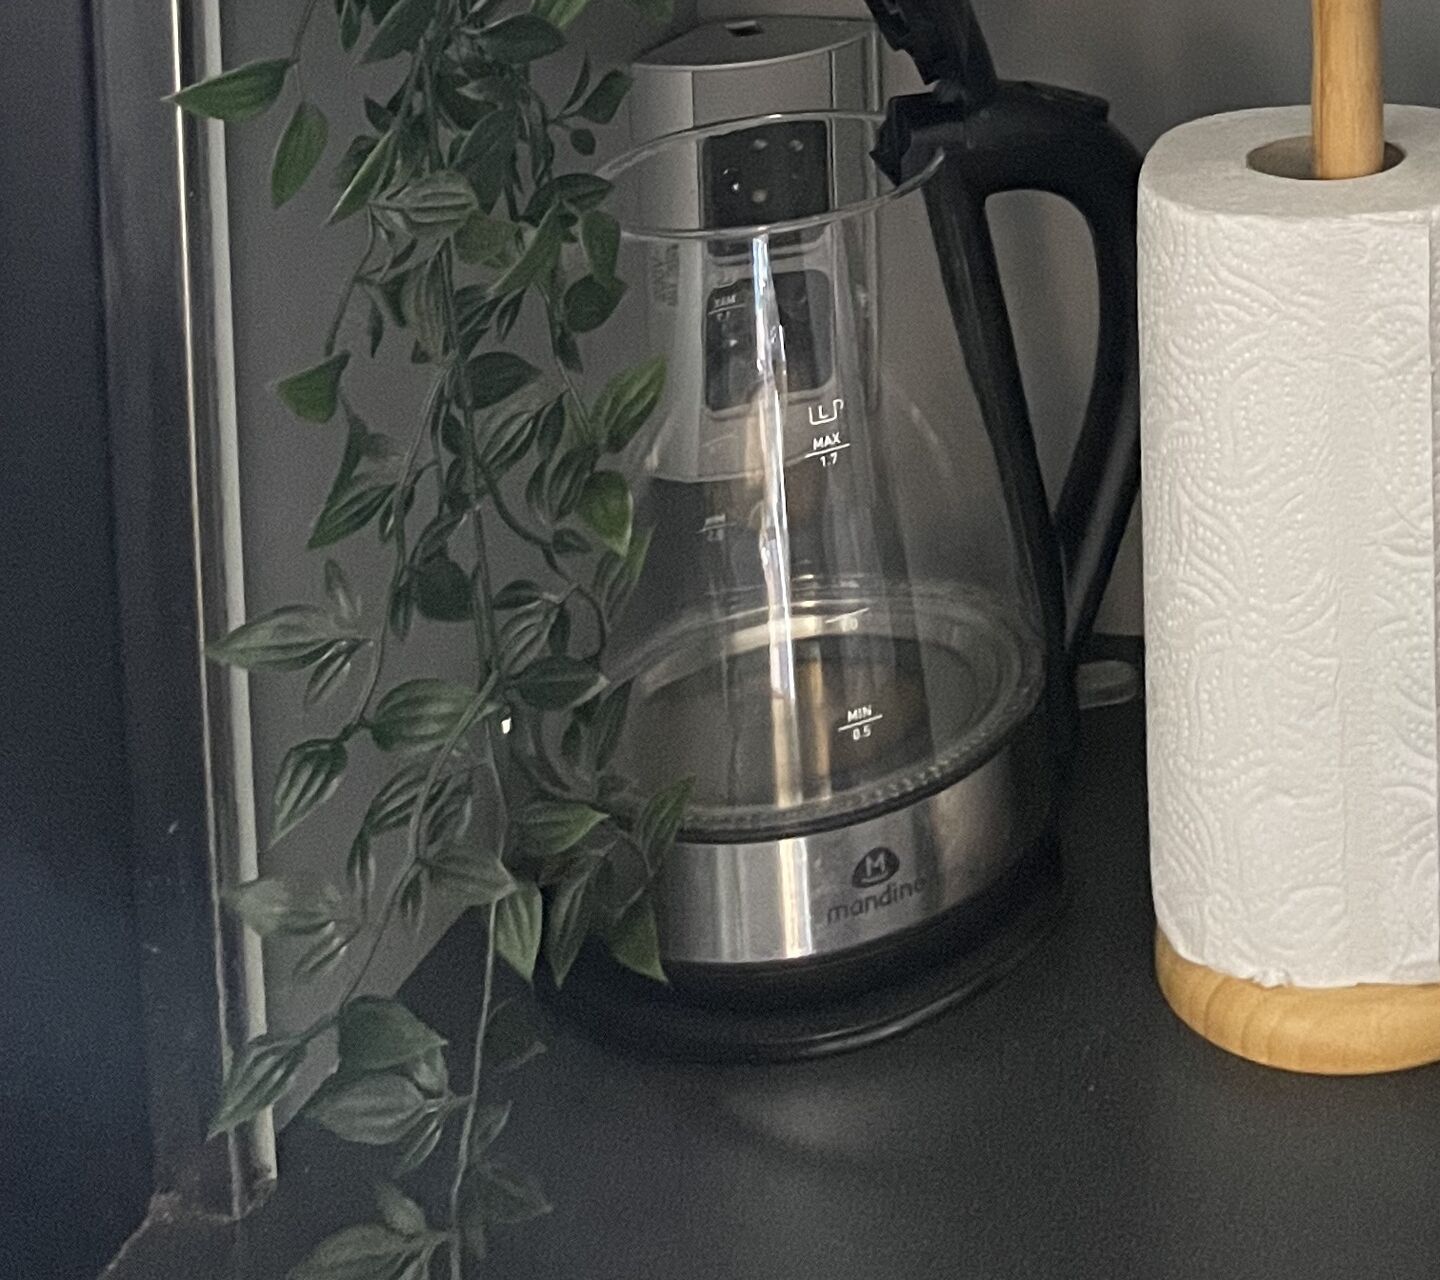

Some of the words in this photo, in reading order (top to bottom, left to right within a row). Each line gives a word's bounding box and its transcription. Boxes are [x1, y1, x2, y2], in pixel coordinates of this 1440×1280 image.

[812, 432, 841, 450] MAX
[820, 452, 838, 467] 1.7
[847, 705, 872, 722] MIN
